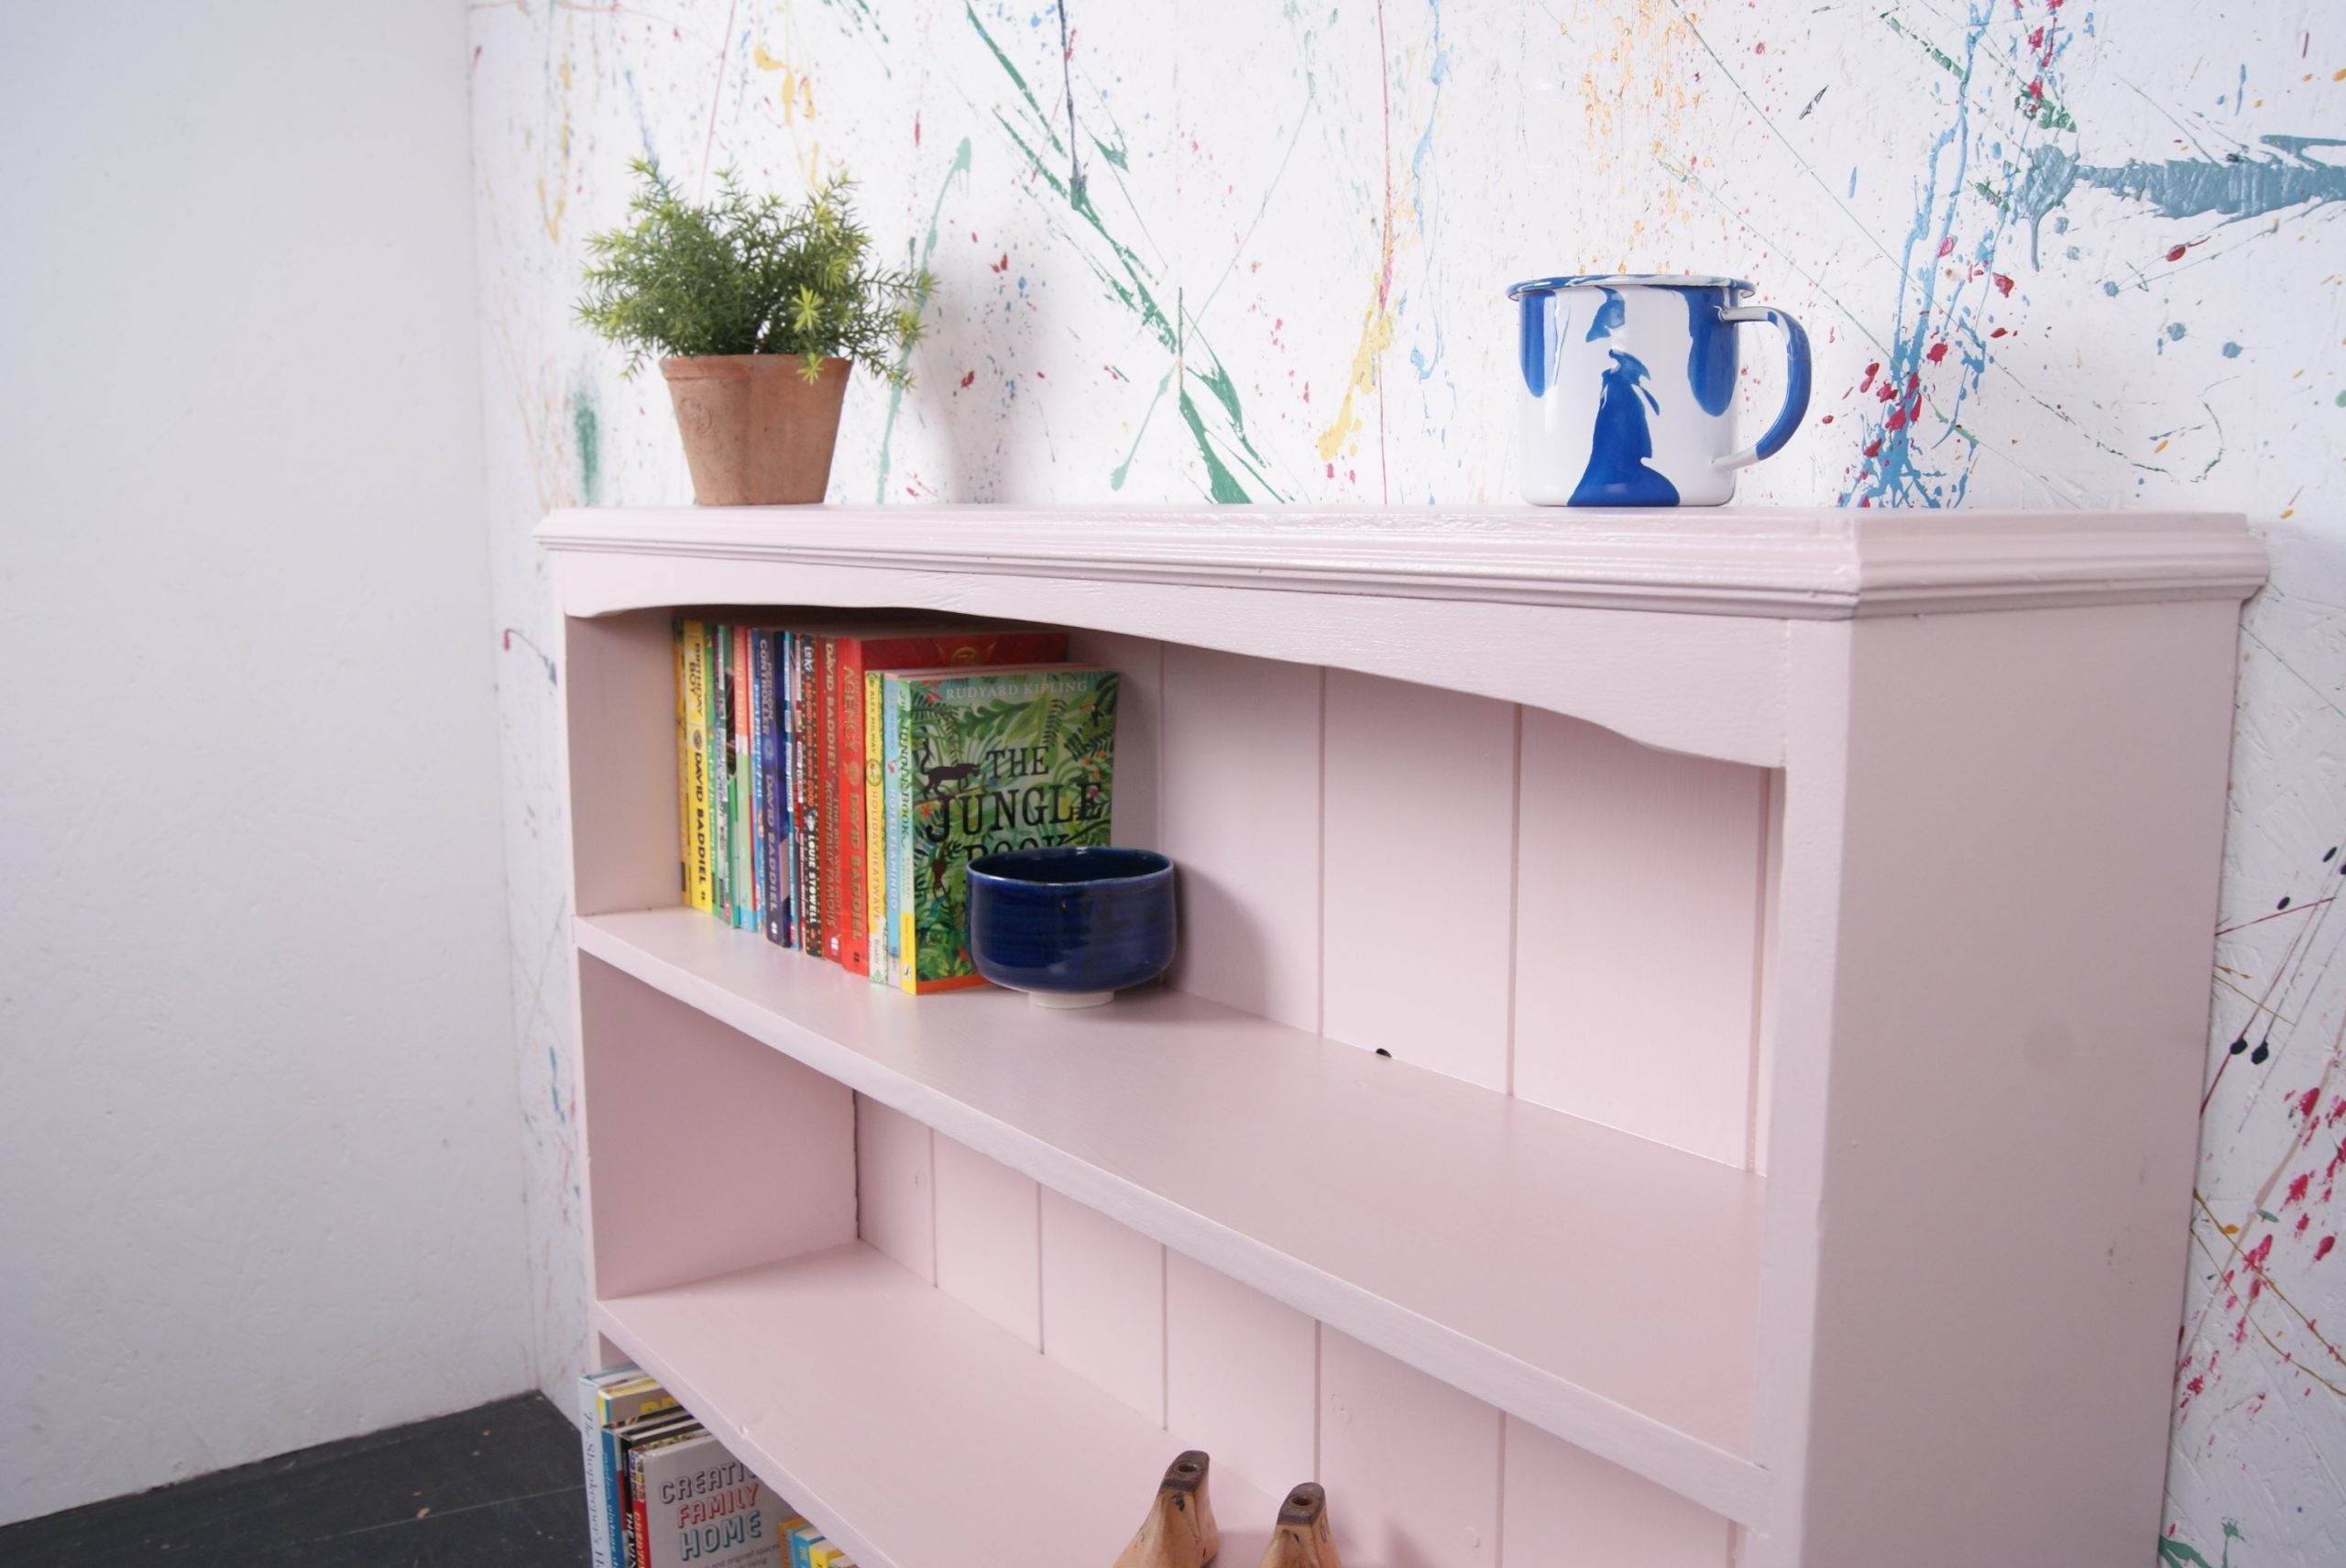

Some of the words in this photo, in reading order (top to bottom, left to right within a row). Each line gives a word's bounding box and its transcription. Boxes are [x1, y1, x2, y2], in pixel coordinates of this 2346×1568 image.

[688, 661, 697, 696] BOY
[695, 642, 704, 717] BIRTHDAY
[760, 640, 770, 735] CONTROLLER
[766, 662, 774, 721] PERSON
[826, 642, 834, 691] DAVID
[945, 683, 1019, 700] RUDYARD
[1023, 680, 1088, 696] KIPLING
[827, 696, 836, 769] BADDIEL
[842, 665, 856, 753] AGENCY
[696, 751, 704, 803] DAVID
[899, 724, 910, 788] JUNGLE
[985, 745, 1051, 780] THE
[766, 774, 774, 828] DAVID
[806, 780, 815, 807] GOOD
[849, 792, 861, 850] DAVID
[871, 790, 880, 849] HOLIDAY
[888, 789, 897, 834] HOTEL
[901, 792, 910, 848] BOOK
[925, 781, 1102, 843] JUNGLE
[696, 808, 706, 884] BADDIEL
[825, 780, 835, 864] ACCIDENTALLY
[768, 831, 777, 912] BADDIEL
[808, 834, 817, 868] LOUIE
[890, 839, 899, 910] FLAMINGO
[809, 872, 817, 924] STOWELL
[826, 868, 836, 927] FAMOUS
[850, 855, 862, 939] BADDIEL
[872, 851, 882, 921] HEATWAVE
[602, 1452, 613, 1500] modern
[660, 1461, 758, 1505] CREATI
[607, 1504, 618, 1552] vintage
[625, 1512, 634, 1539] THE
[677, 1481, 760, 1530] FAMILY
[679, 1508, 762, 1562] HOME
